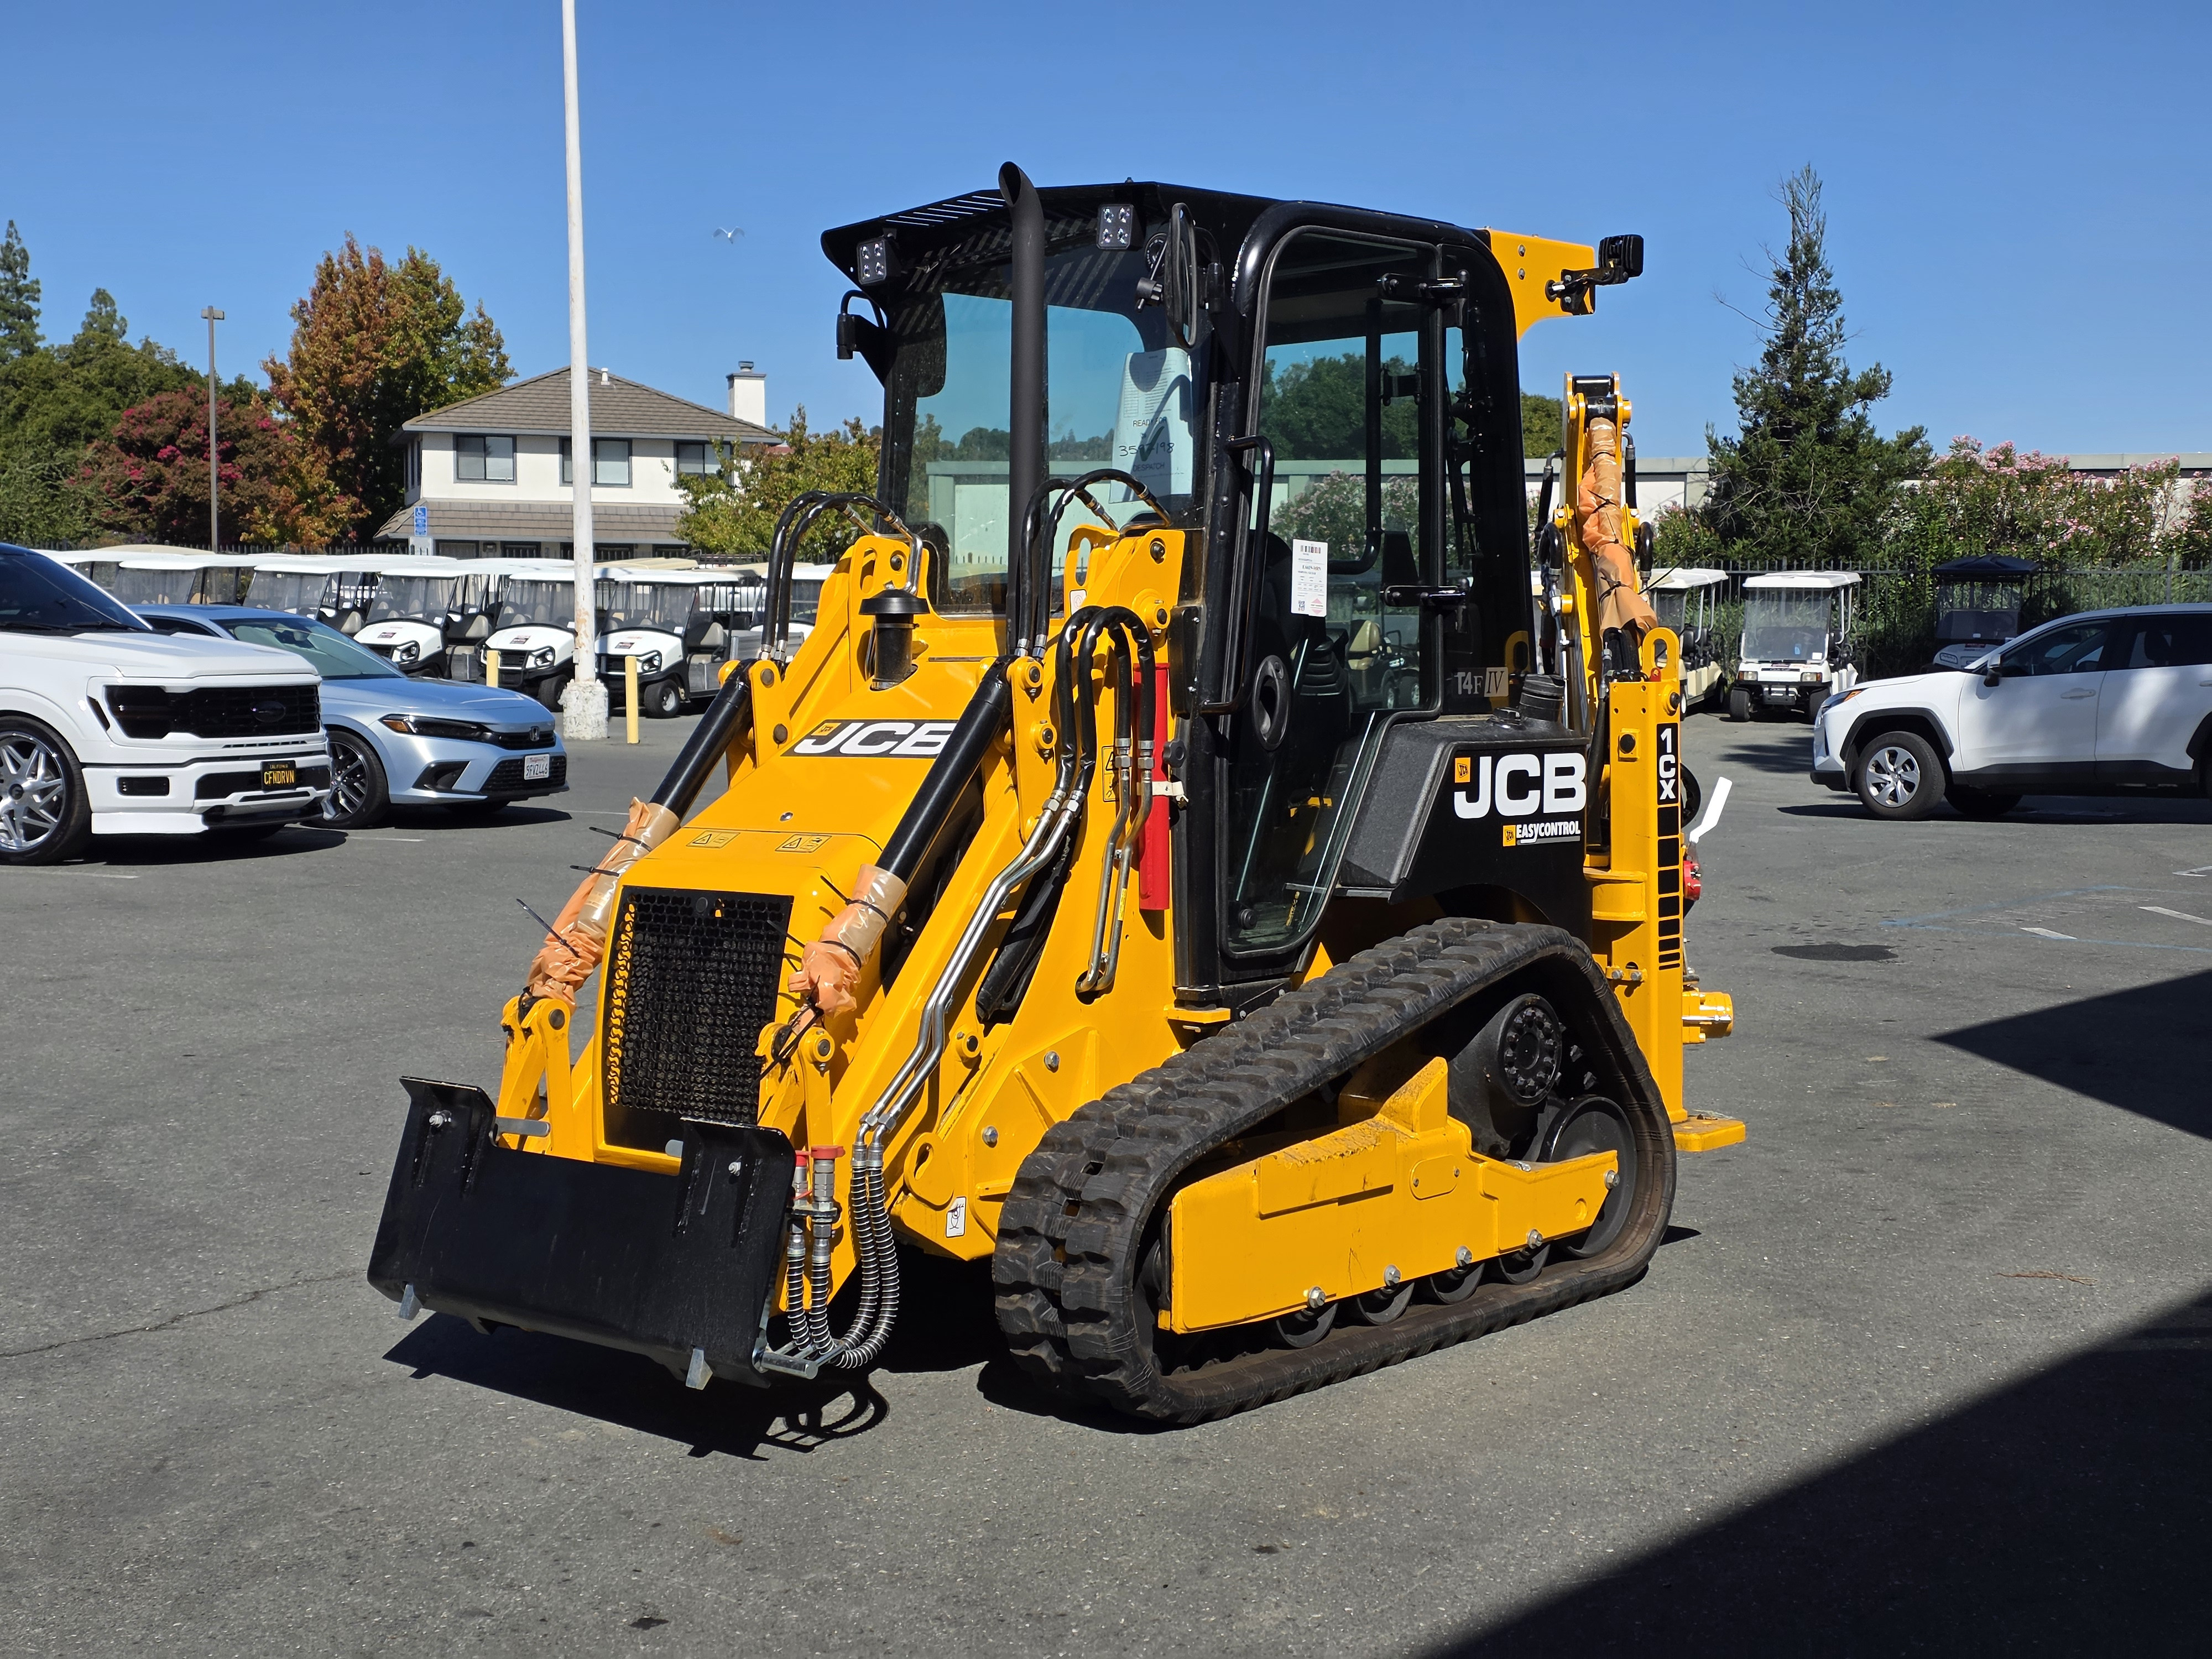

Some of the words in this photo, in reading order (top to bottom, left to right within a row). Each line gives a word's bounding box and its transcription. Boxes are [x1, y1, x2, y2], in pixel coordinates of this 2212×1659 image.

[1132, 462, 1165, 472] DESPATCH
[794, 722, 957, 755] JCB
[1660, 728, 1676, 800] 1CX
[1454, 753, 1587, 819] JCB
[1516, 821, 1581, 844] EASYCONTROL
